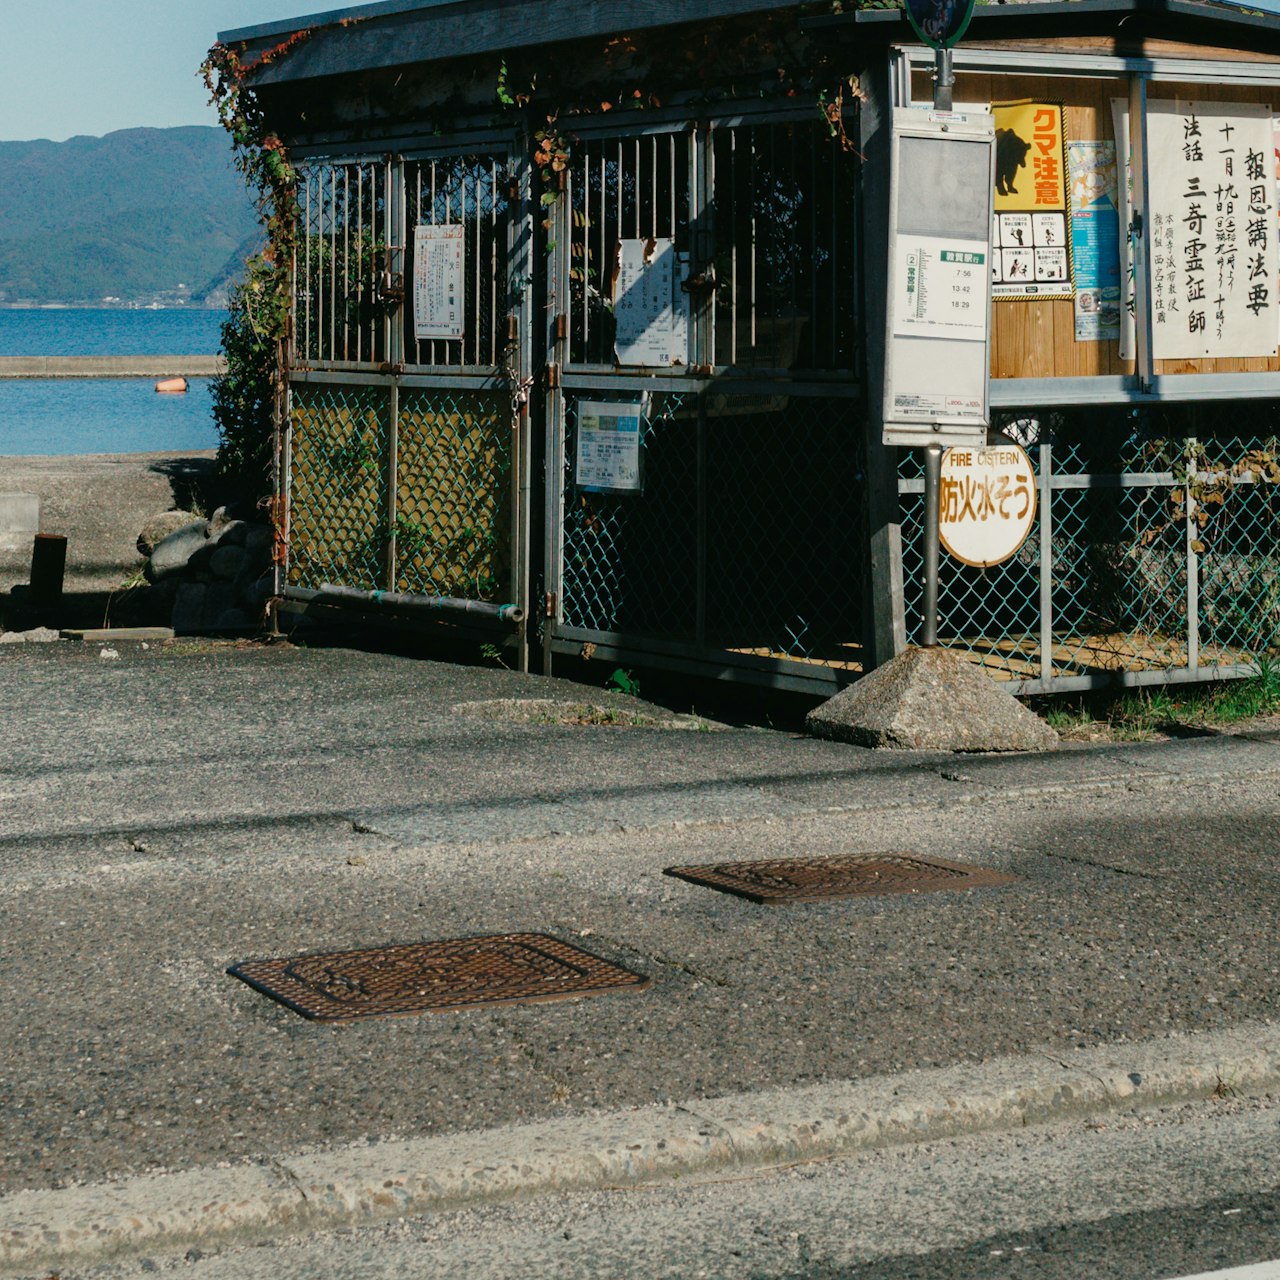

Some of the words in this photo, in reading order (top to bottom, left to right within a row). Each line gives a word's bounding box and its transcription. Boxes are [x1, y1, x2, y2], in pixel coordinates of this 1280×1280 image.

[1033, 109, 1060, 205] クマ注意
[1182, 114, 1204, 162] 法話
[1218, 123, 1235, 177] 十一月
[1244, 148, 1272, 316] 報恩講法要
[909, 256, 916, 264] 2
[956, 269, 972, 277] 7:56
[952, 285, 971, 293] 13:42
[950, 453, 972, 467] FIRE
[977, 451, 1020, 466] CISTERN
[939, 474, 1030, 524] 防火水そう
